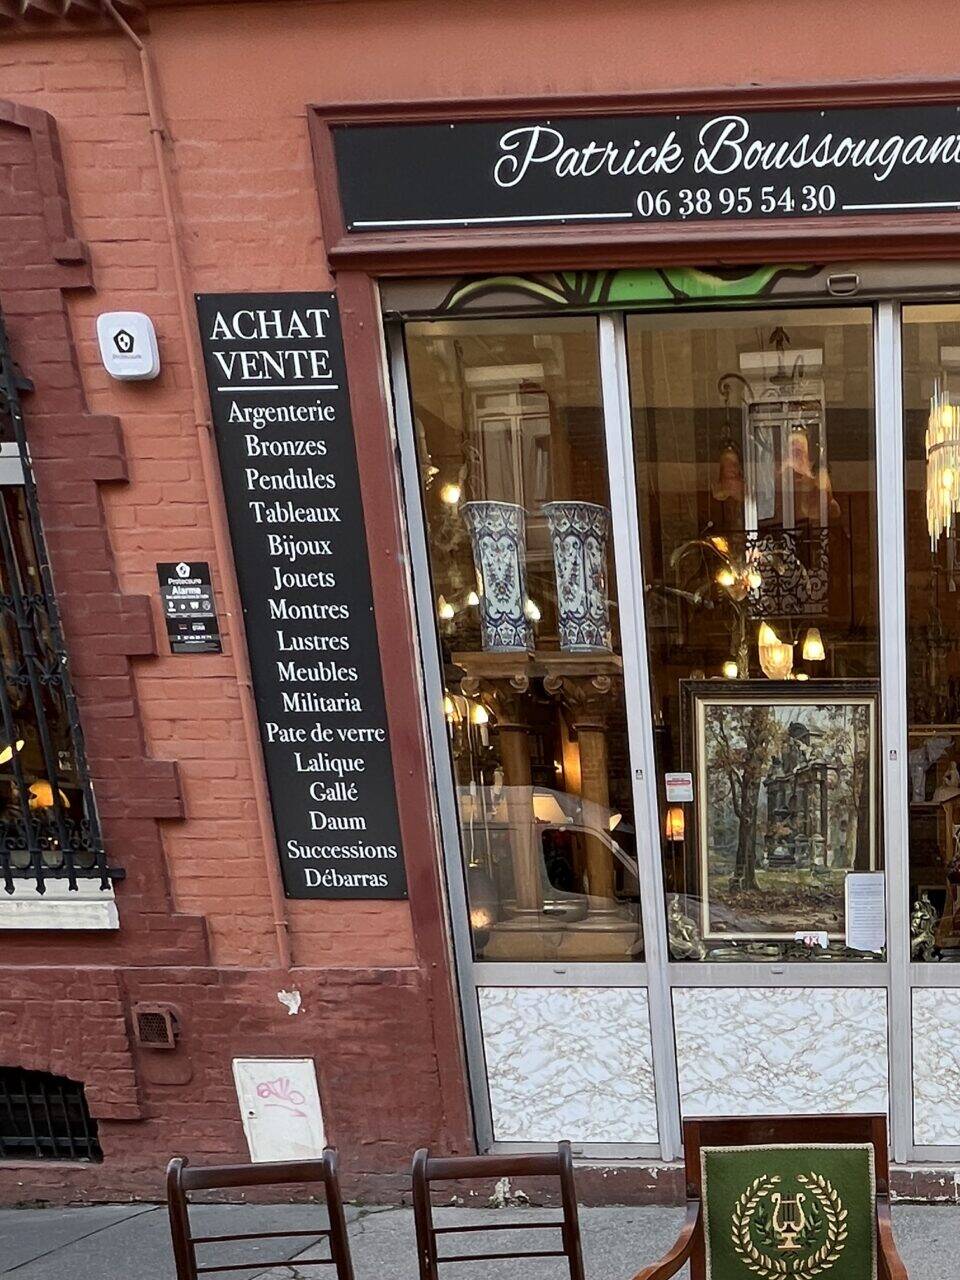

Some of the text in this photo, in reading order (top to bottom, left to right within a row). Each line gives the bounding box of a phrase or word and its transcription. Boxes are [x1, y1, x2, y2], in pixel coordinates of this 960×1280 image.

[492, 125, 686, 188] Patrick
[636, 184, 836, 217] 06 38 95 54 30
[209, 308, 331, 340] ACHAT
[212, 349, 333, 380] VENTE
[227, 399, 336, 430] Argenterie
[244, 434, 327, 457] Bronzes
[244, 467, 336, 490] Pendules
[248, 501, 342, 523] Tableaux
[266, 534, 333, 562] Bijoux
[272, 566, 336, 591] Jouets
[267, 598, 350, 620] Montres
[276, 630, 350, 651] Lustres
[276, 661, 358, 682] Meubles
[281, 692, 363, 713] Militaria
[265, 722, 386, 743] Pate de verre
[293, 751, 365, 778] Lalique
[309, 781, 359, 802] Gallé
[308, 810, 367, 831] Daum
[286, 839, 398, 859] Successions
[303, 868, 389, 888] Débarras
